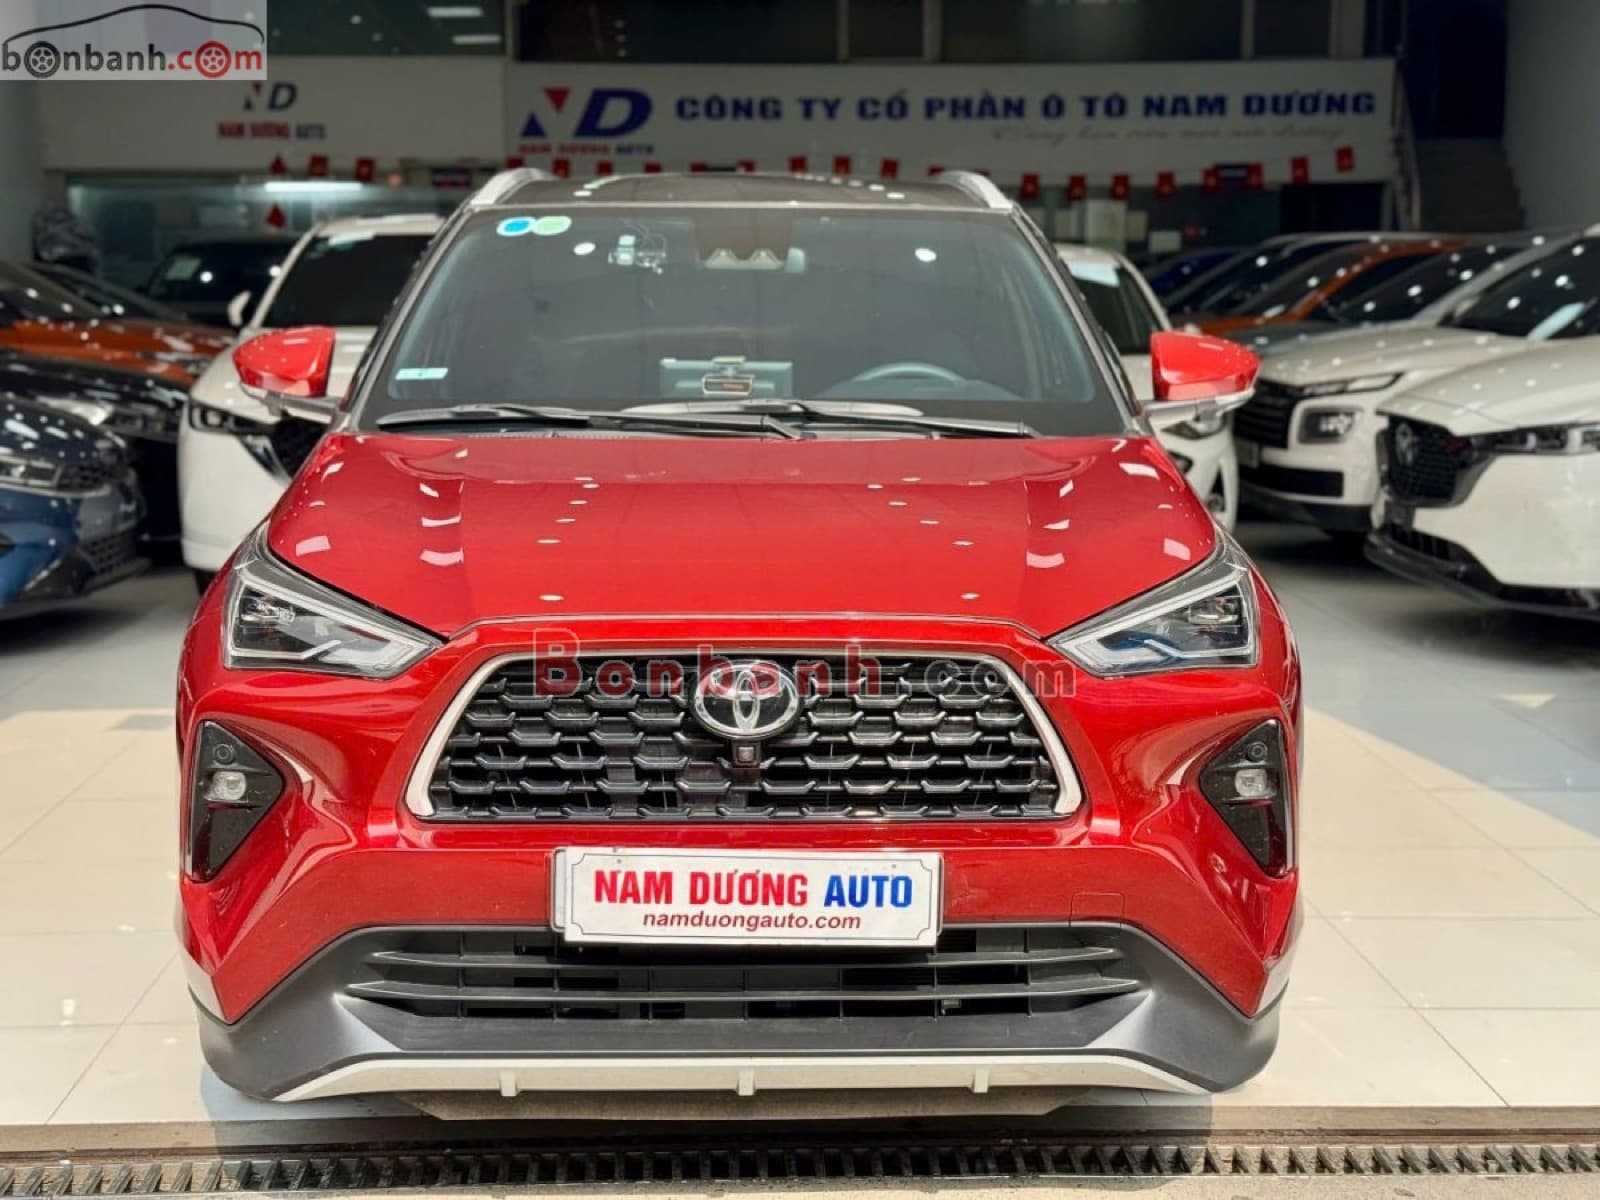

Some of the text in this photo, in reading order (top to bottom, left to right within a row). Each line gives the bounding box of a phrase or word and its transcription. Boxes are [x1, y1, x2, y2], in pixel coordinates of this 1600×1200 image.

[798, 97, 842, 120] TY
[1142, 95, 1227, 117] NAM
[594, 868, 913, 908] NAM DƯƠNG AUTO
[643, 910, 861, 932] namduongauto.com
